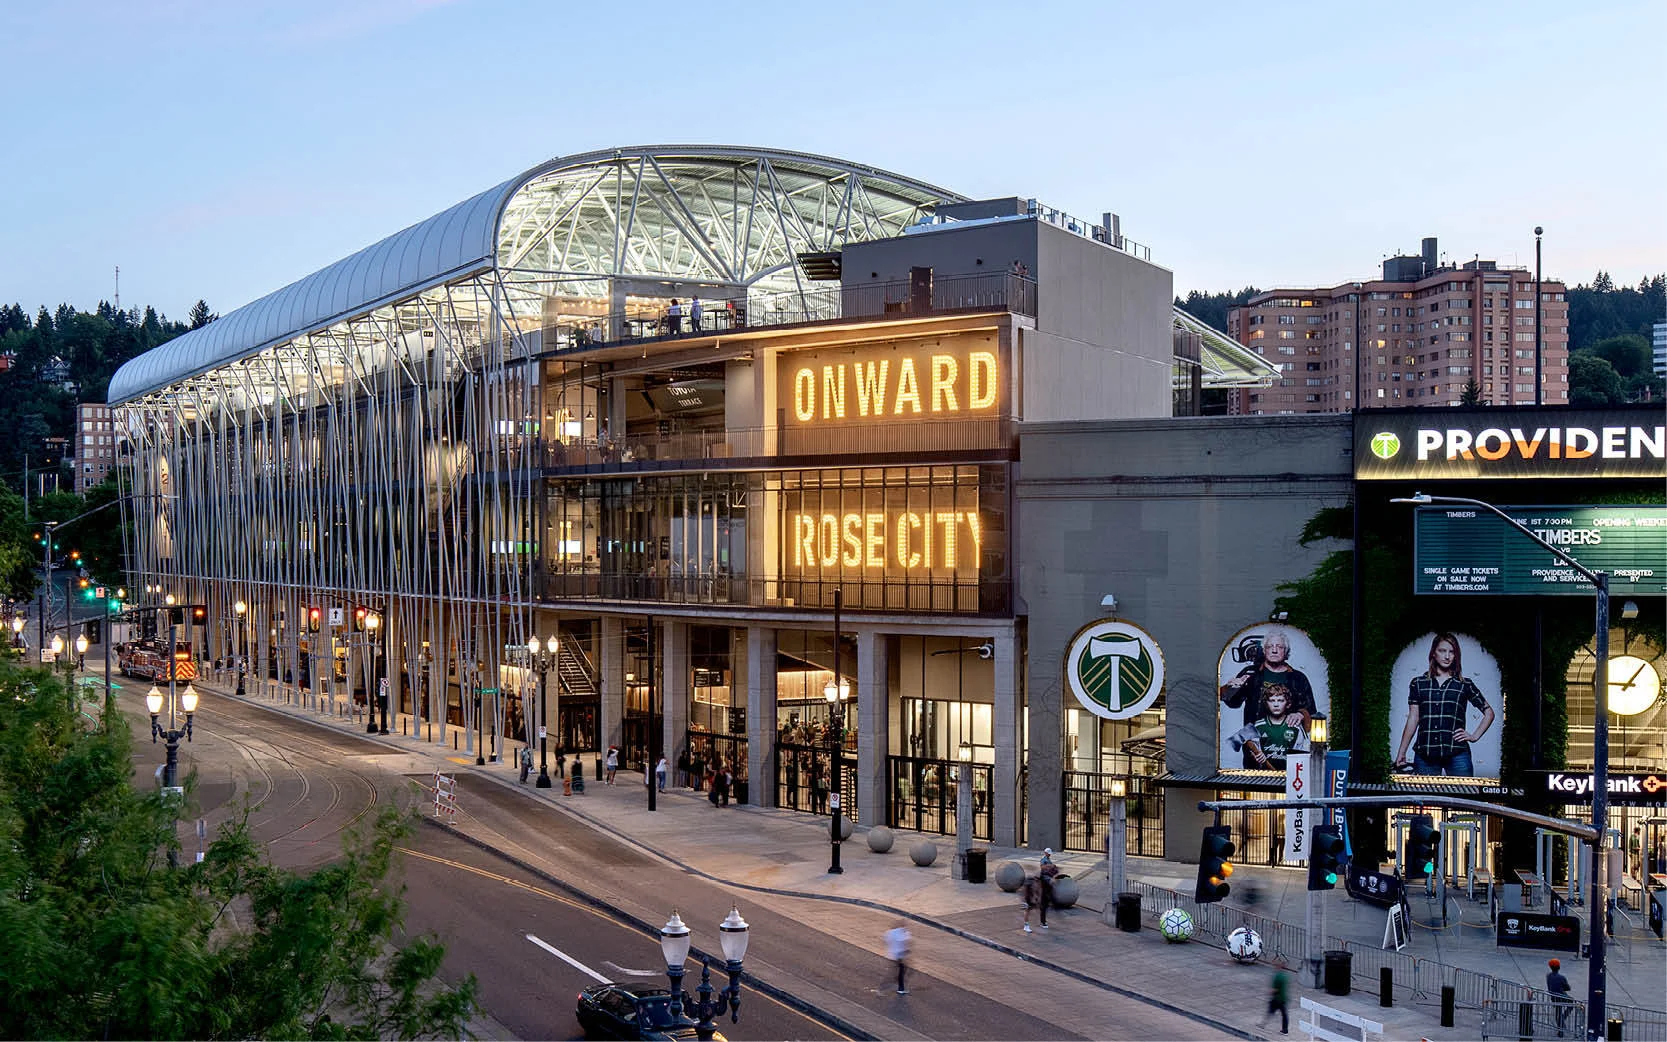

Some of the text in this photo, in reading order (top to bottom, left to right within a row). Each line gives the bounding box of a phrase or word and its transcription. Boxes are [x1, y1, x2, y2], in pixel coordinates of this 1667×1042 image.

[794, 351, 998, 422] ONWARD
[1417, 426, 1666, 461] PROVIDEN
[1592, 518, 1631, 527] OPENING
[794, 512, 885, 568] ROSE
[1534, 529, 1602, 545] TIMBERS
[1424, 567, 1499, 575] SINGLE GAME TICKETS
[1613, 569, 1654, 577] PRESENTED
[1437, 575, 1487, 583] ON SALE NOW
[1482, 786, 1500, 794] Gate
